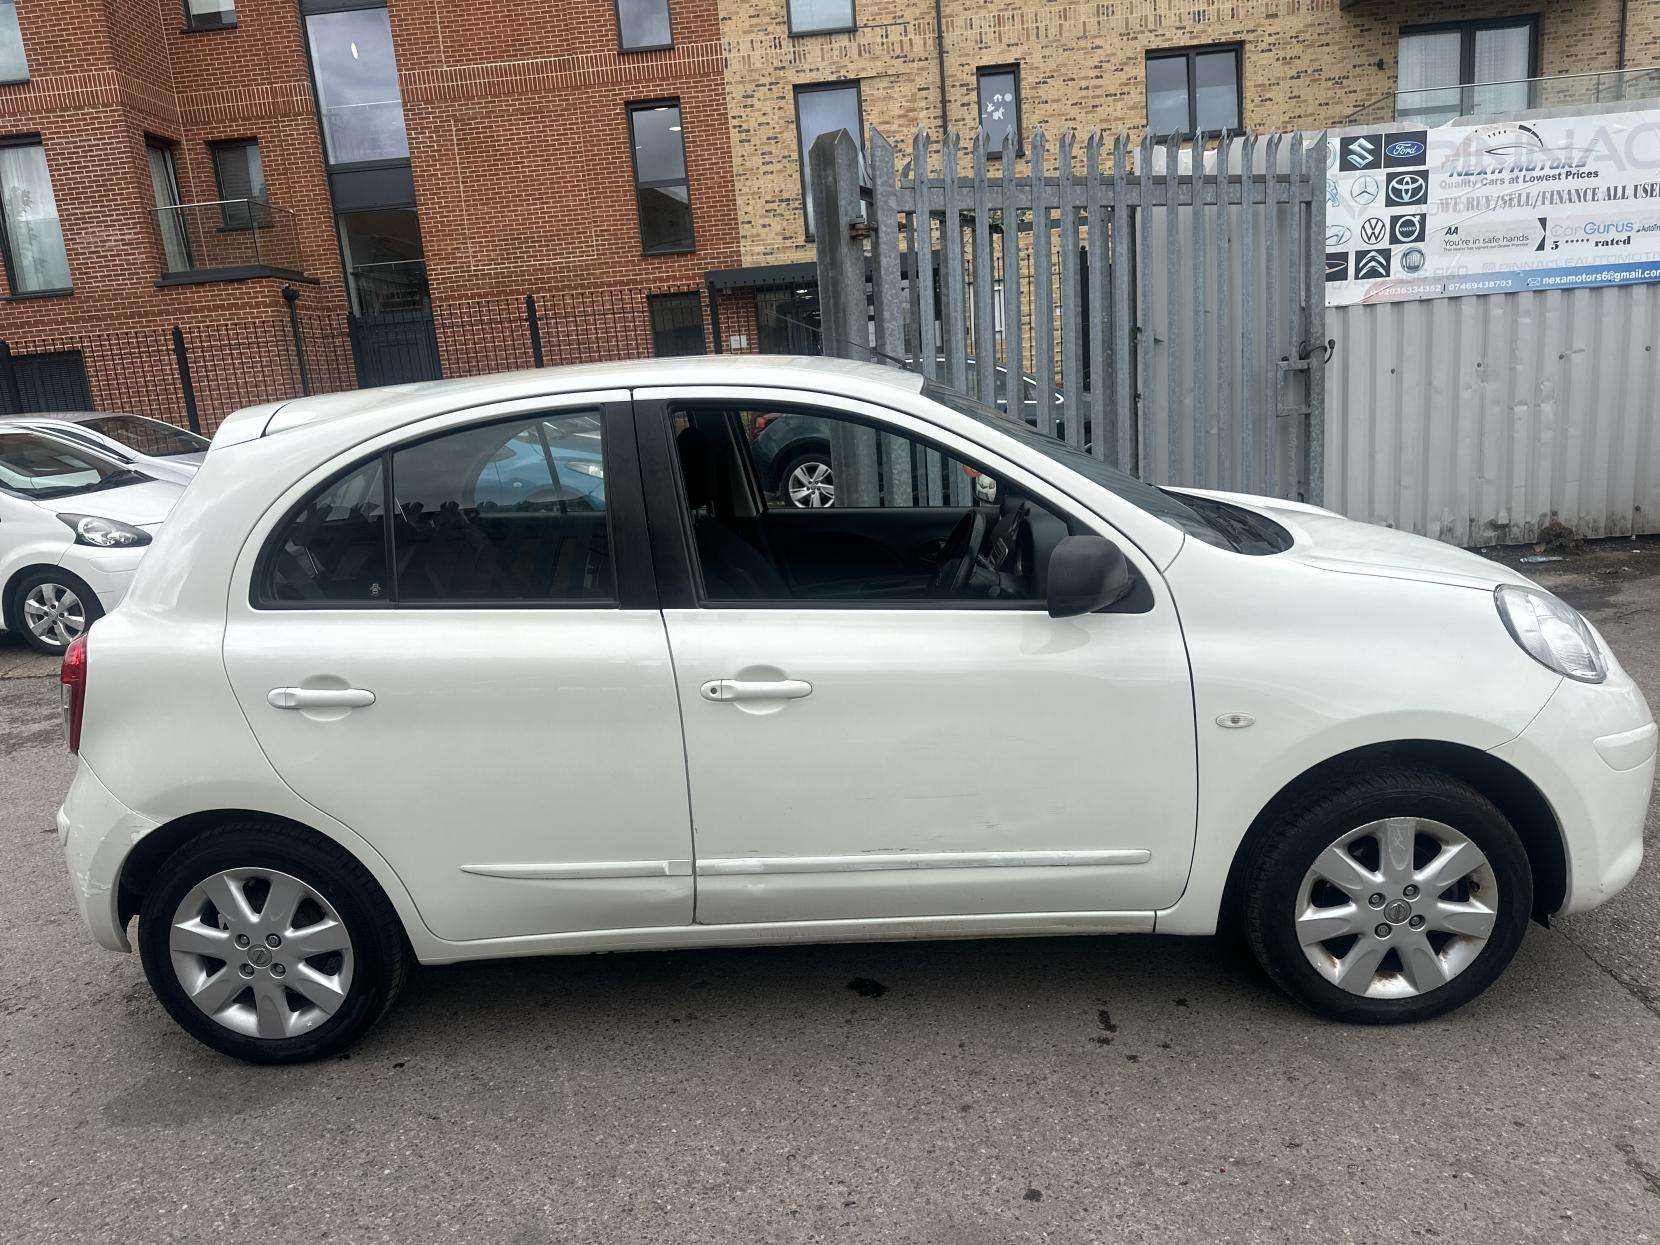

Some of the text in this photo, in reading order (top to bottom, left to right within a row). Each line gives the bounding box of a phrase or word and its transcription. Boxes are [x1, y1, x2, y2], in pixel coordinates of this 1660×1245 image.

[1393, 143, 1416, 155] Ford
[1440, 169, 1599, 190] Quality Cars at Lowest Prices
[1602, 185, 1628, 201] ALL
[1633, 182, 1660, 199] USE
[1445, 227, 1458, 235] AA
[1444, 238, 1470, 247] You're
[1483, 235, 1501, 244] safe
[1502, 234, 1529, 243] hands
[1551, 235, 1631, 250] 5 rated
[1449, 280, 1512, 291] 07469438703
